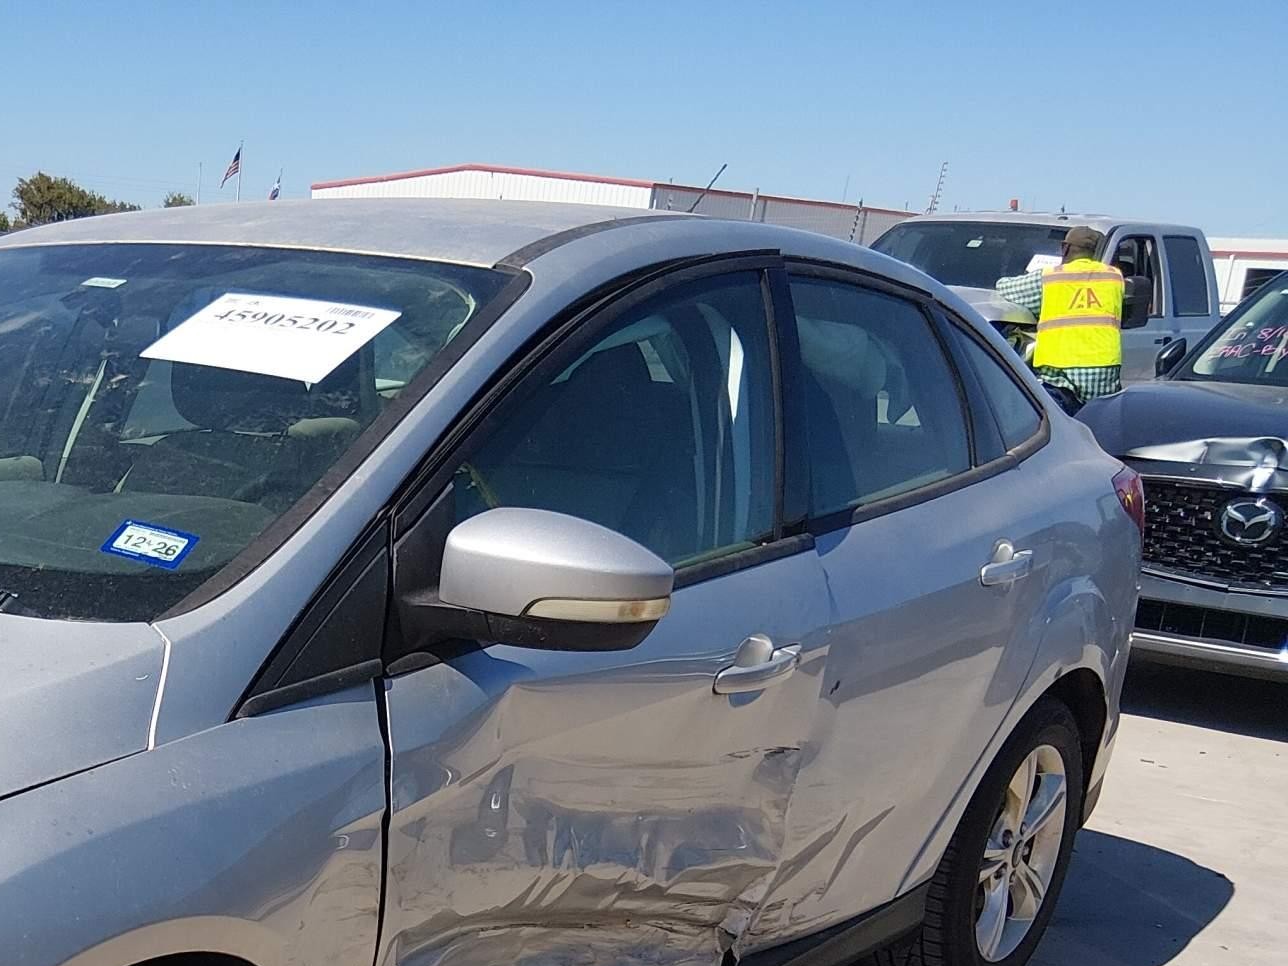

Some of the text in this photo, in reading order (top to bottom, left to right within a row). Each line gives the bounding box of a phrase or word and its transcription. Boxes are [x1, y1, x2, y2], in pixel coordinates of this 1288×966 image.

[214, 309, 355, 335] 45905202
[123, 534, 147, 548] 12
[152, 541, 179, 556] 26
